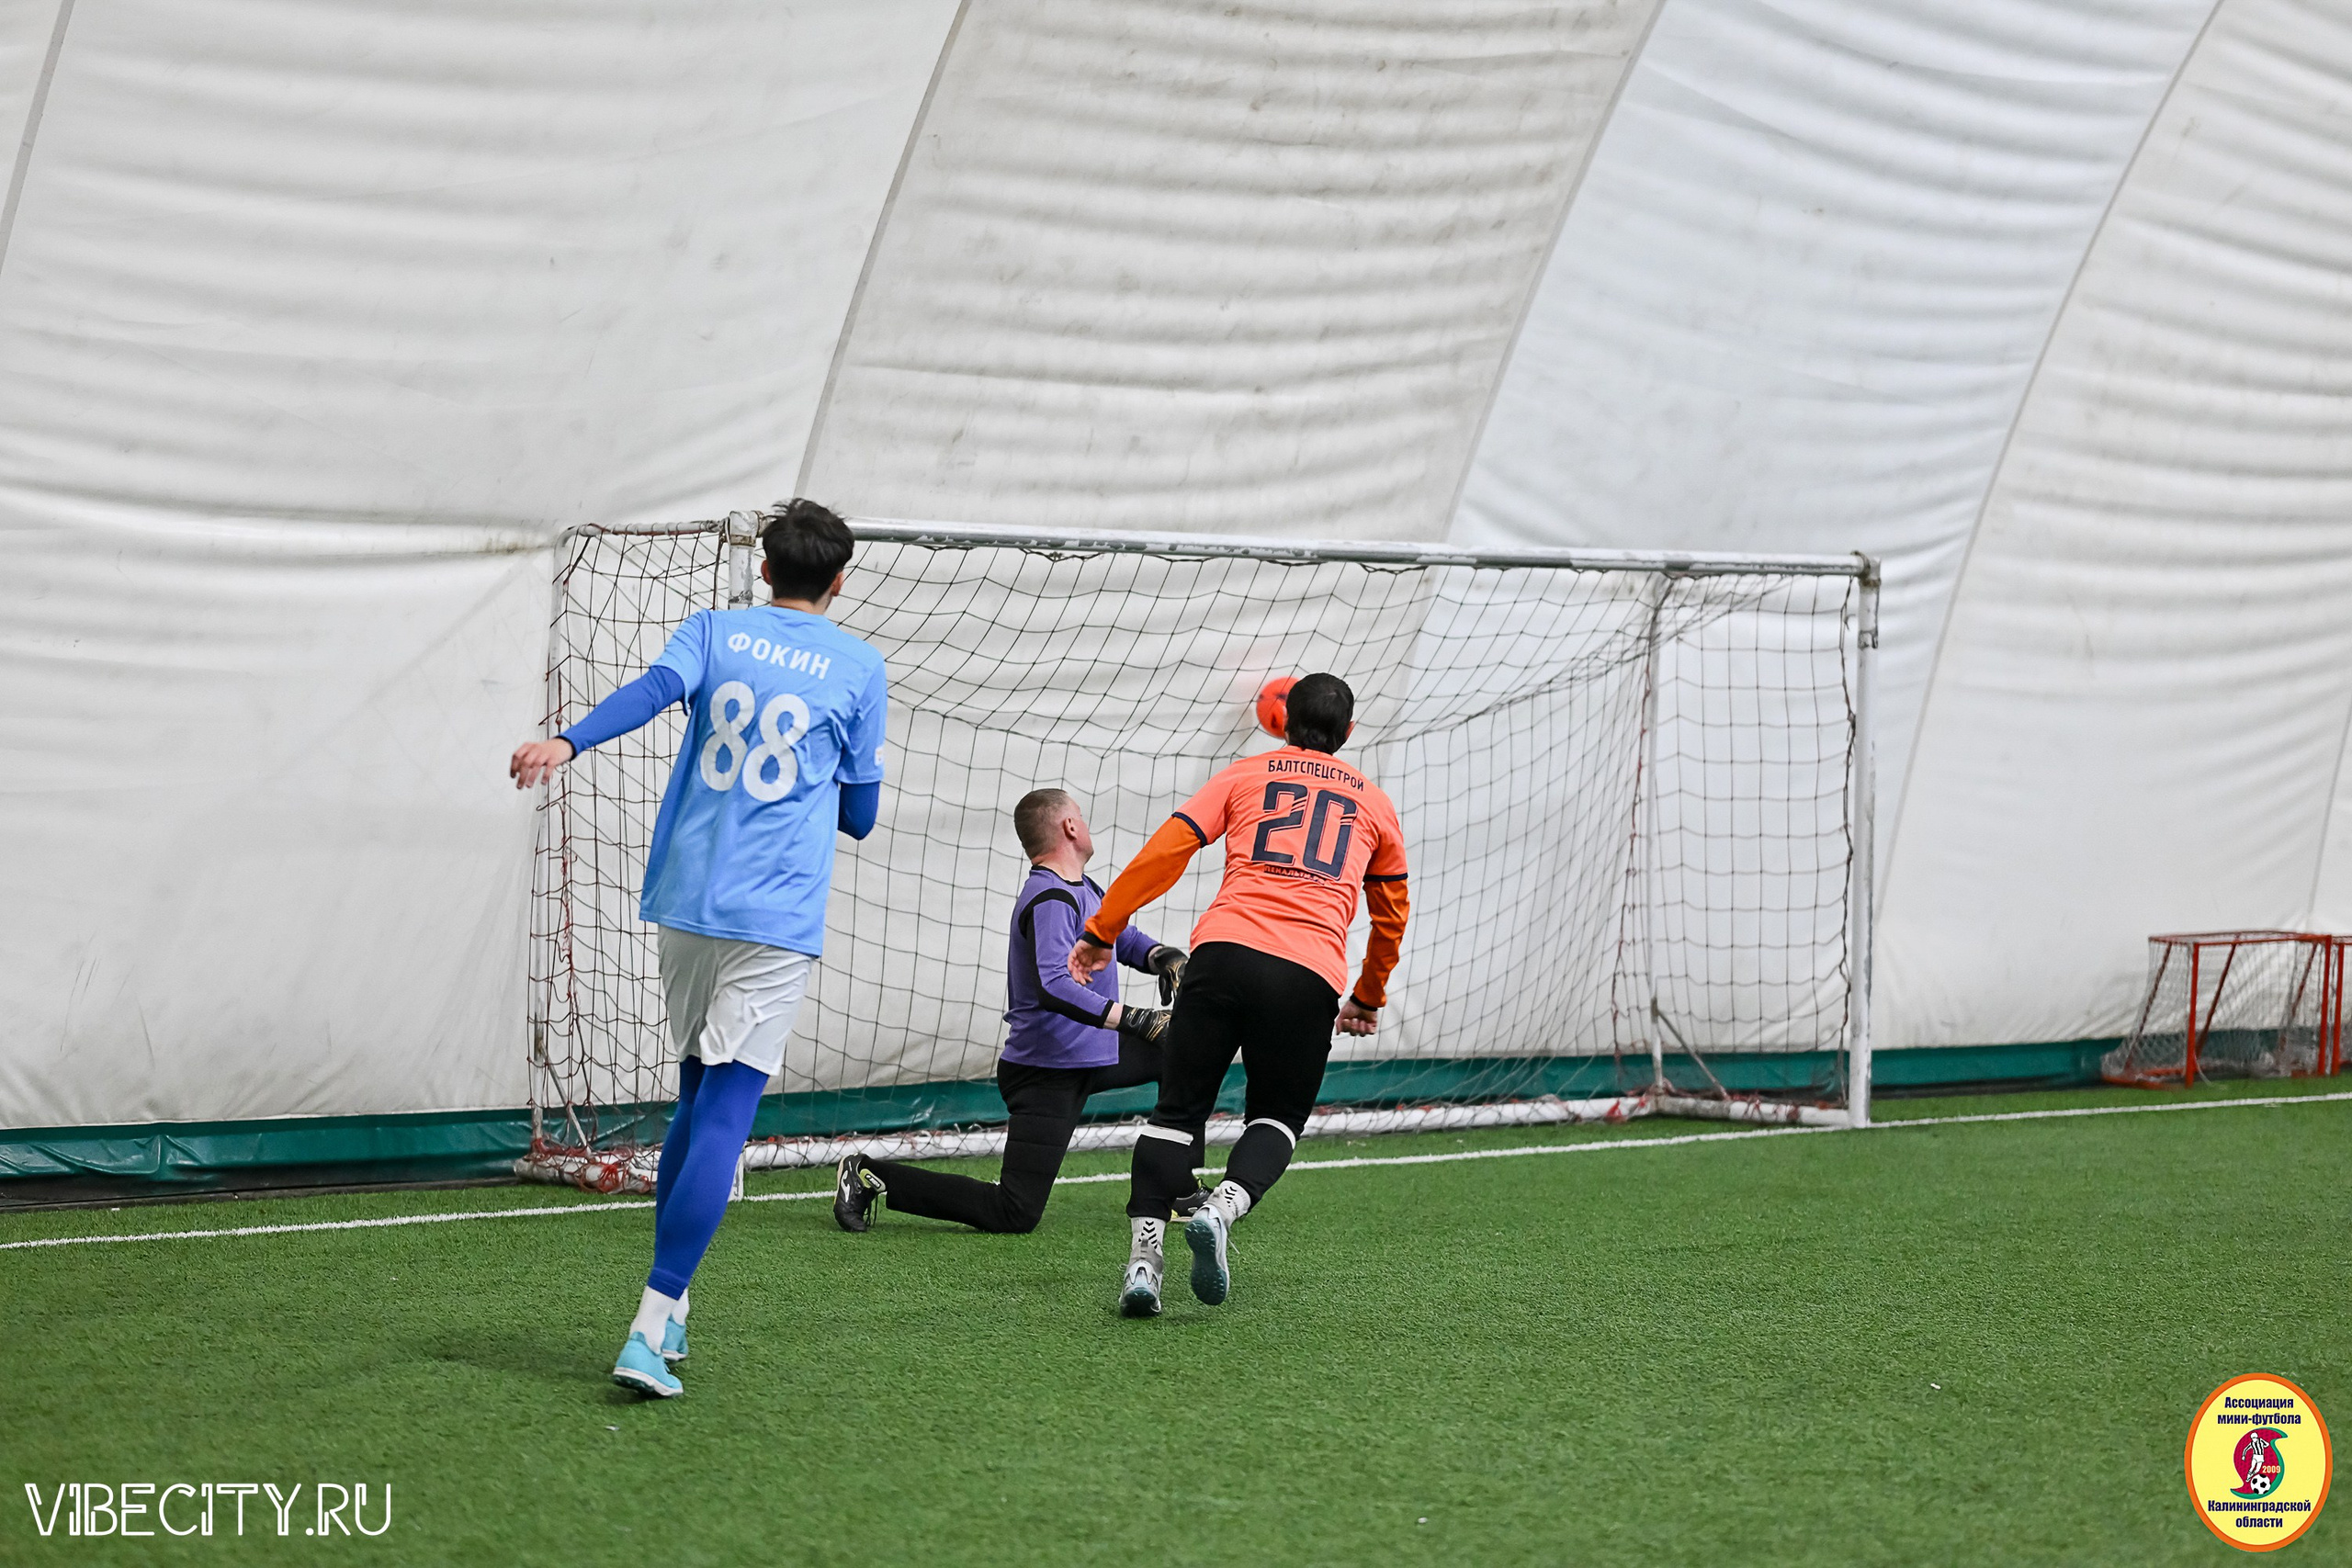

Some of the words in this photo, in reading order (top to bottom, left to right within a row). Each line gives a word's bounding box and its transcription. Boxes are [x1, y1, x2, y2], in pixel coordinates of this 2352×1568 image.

[727, 631, 831, 681] ФОКИН
[699, 680, 811, 803] 88
[1268, 760, 1364, 792] БАЛТСПЕЦСТРОЙ
[1250, 781, 1359, 881] 20
